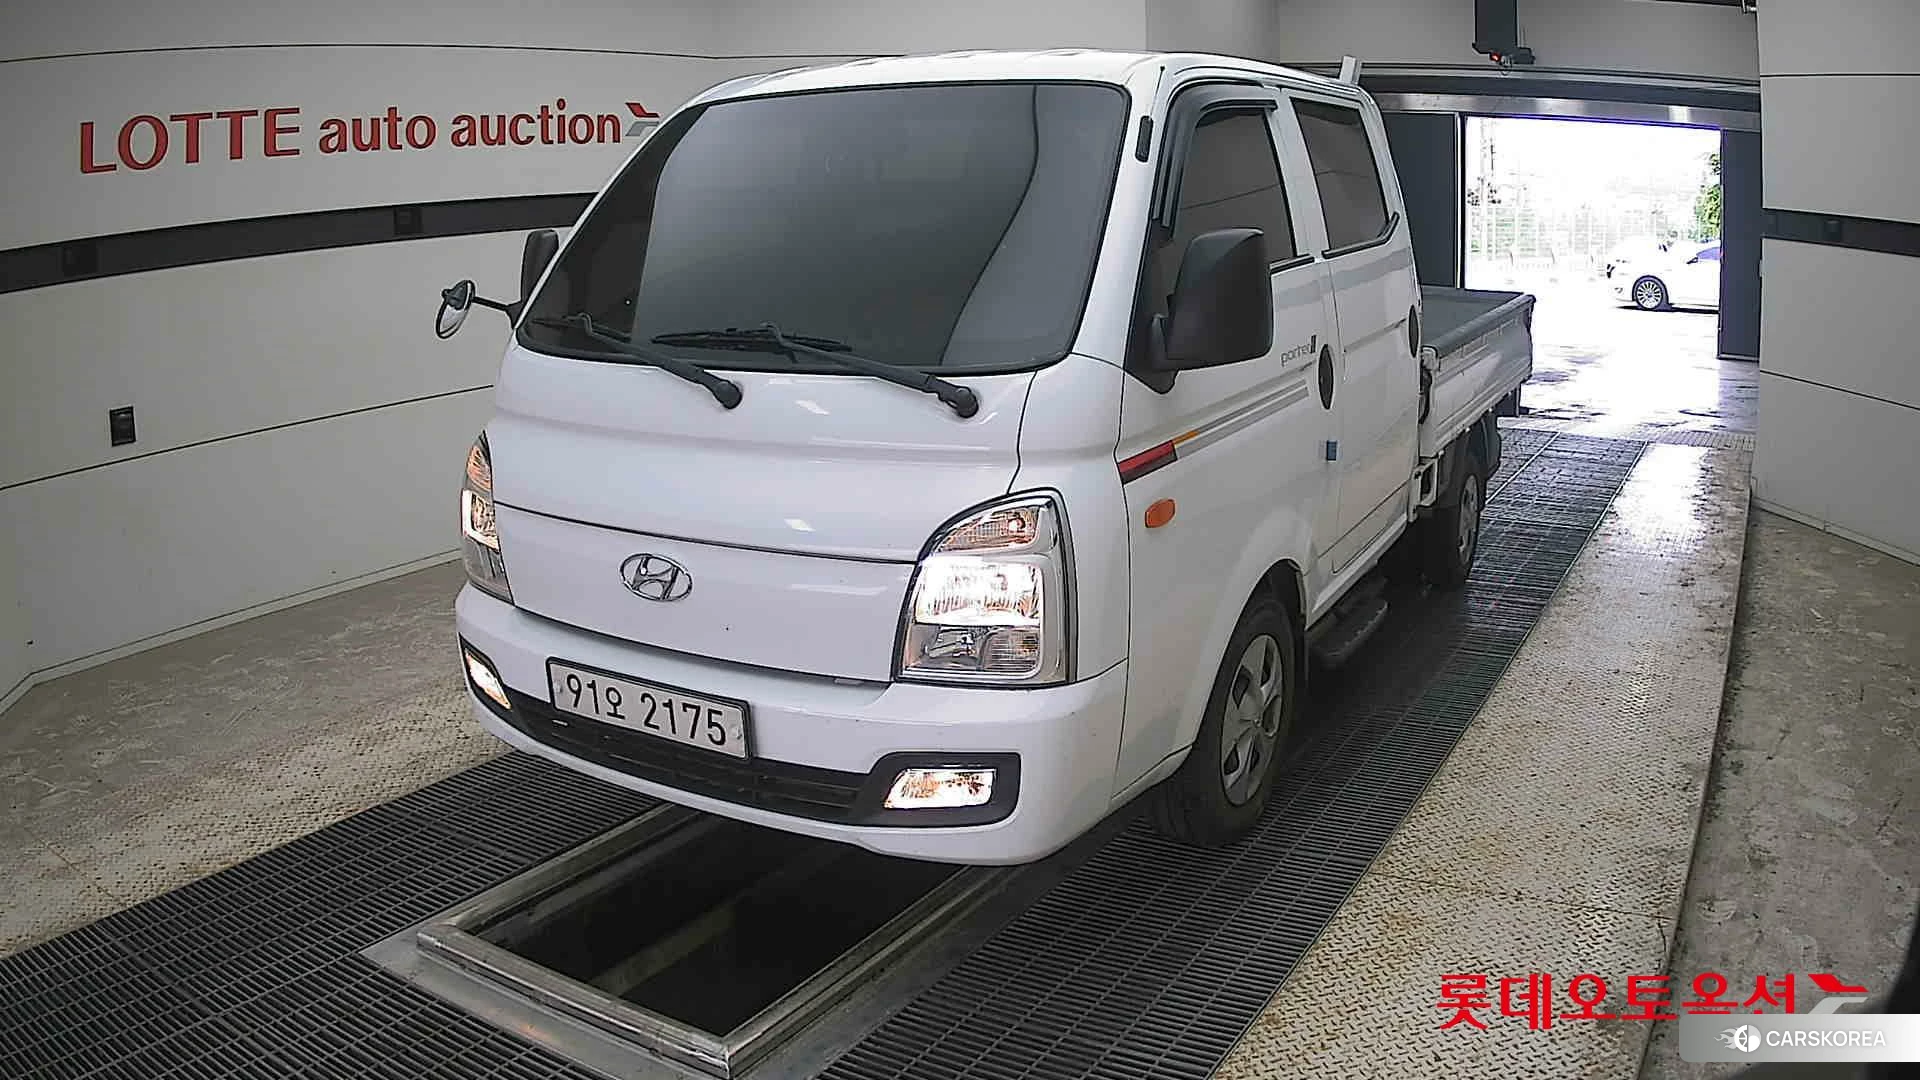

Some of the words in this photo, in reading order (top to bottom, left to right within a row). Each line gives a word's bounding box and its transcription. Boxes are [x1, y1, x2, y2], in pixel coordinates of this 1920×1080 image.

[80, 107, 301, 174] LOTTE
[319, 107, 436, 154] auto
[451, 99, 621, 147] auction
[566, 673, 626, 720] 91오
[640, 692, 727, 746] 2175
